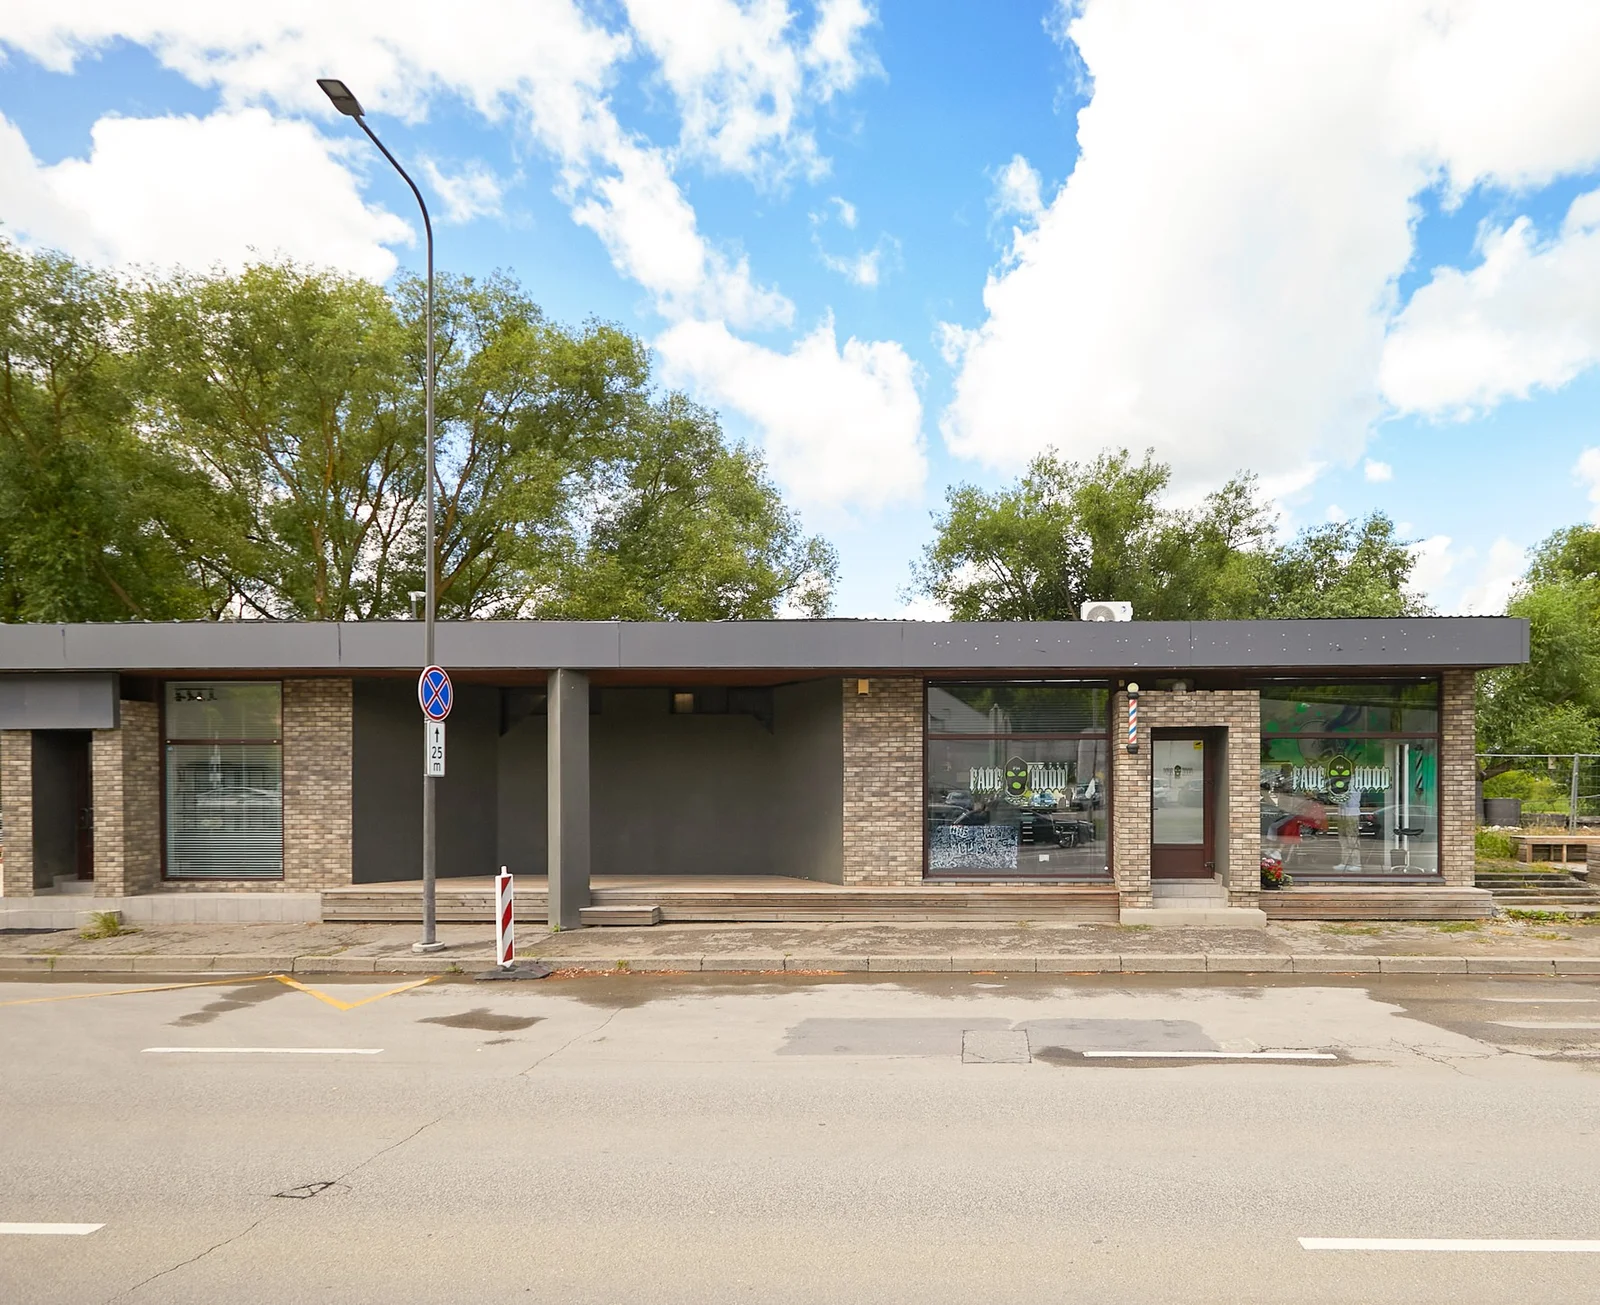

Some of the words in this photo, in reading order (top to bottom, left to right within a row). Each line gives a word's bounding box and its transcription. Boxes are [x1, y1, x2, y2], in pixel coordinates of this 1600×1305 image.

[432, 746, 442, 759] 25
[433, 762, 441, 771] m
[969, 766, 1003, 792] FADE
[1031, 767, 1066, 792] HOOD
[1292, 765, 1326, 791] FADE
[1354, 765, 1391, 791] HOOD
